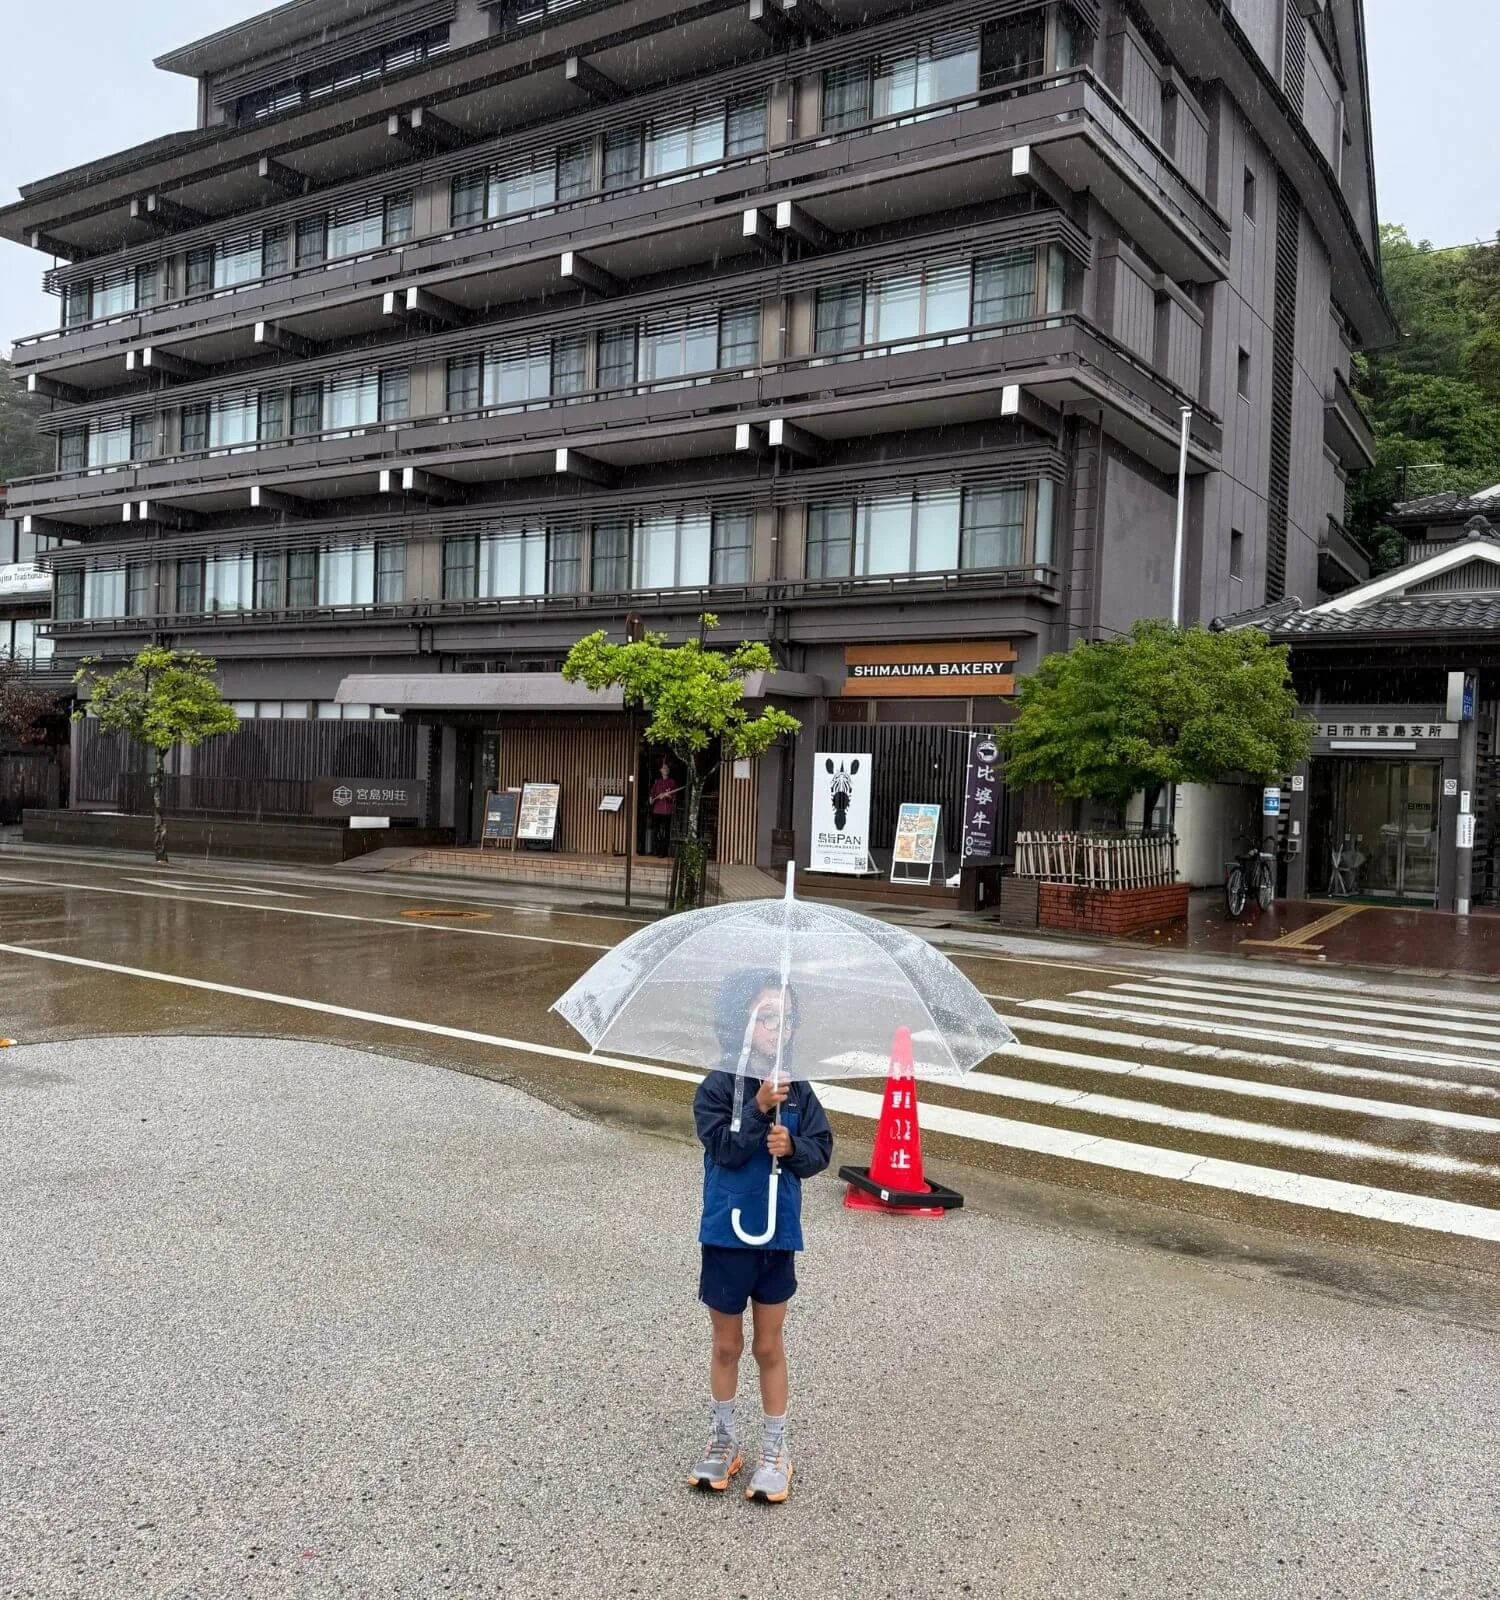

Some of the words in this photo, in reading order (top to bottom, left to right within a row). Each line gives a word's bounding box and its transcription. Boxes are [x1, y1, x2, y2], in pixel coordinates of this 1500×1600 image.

[854, 664, 935, 677] SHIMAUMA
[939, 662, 1005, 675] BAKERY
[356, 788, 407, 801] 宮島別荘
[972, 764, 996, 830] 比婆牛
